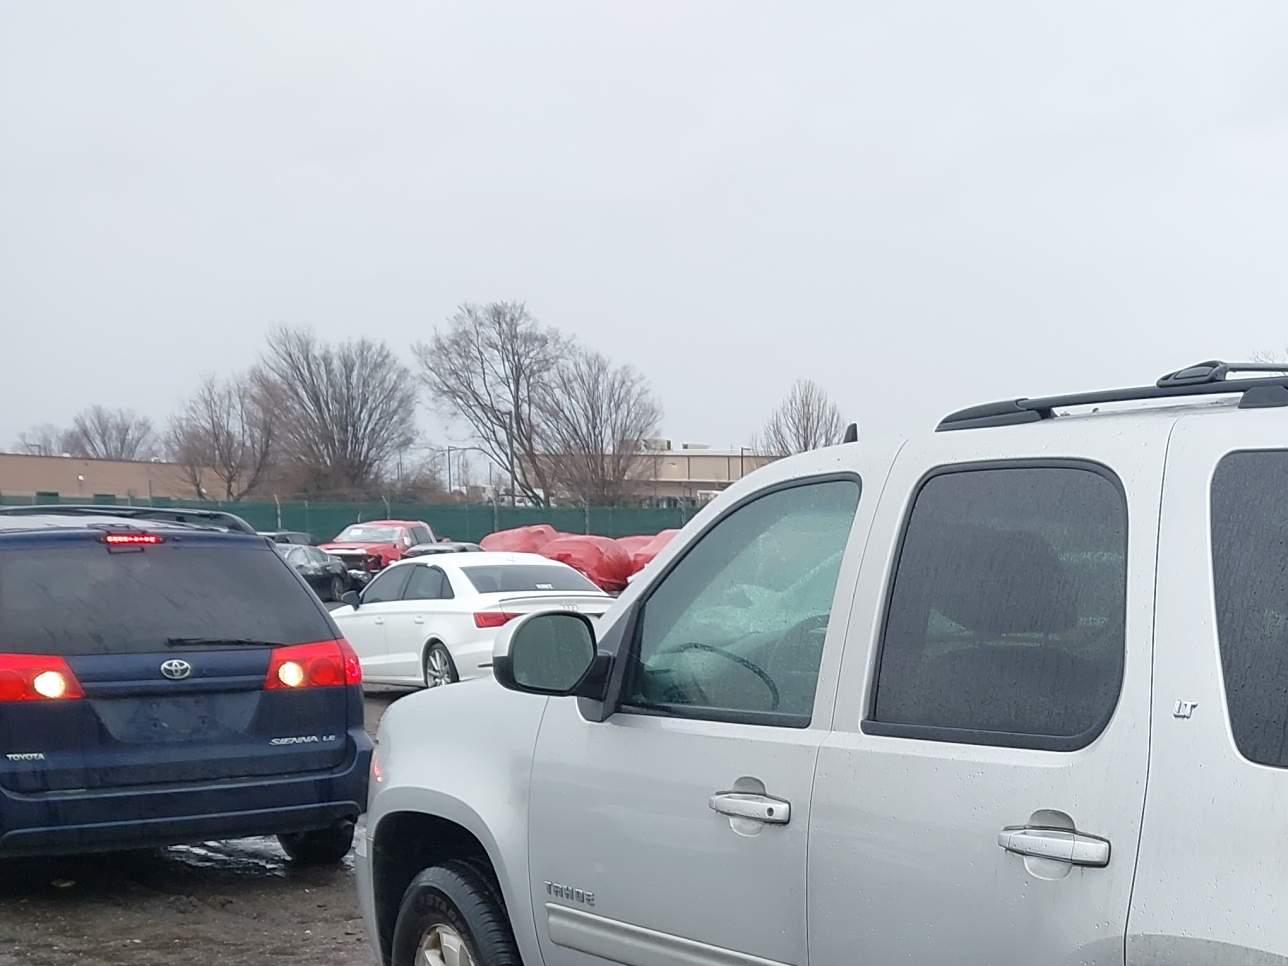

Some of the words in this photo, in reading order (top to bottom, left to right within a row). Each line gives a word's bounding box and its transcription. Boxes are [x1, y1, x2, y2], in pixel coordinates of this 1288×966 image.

[1173, 699, 1198, 719] LT
[269, 735, 318, 747] SIENNA
[322, 734, 336, 742] LE
[6, 752, 46, 762] TOYOTA
[543, 880, 596, 907] TAHOE
